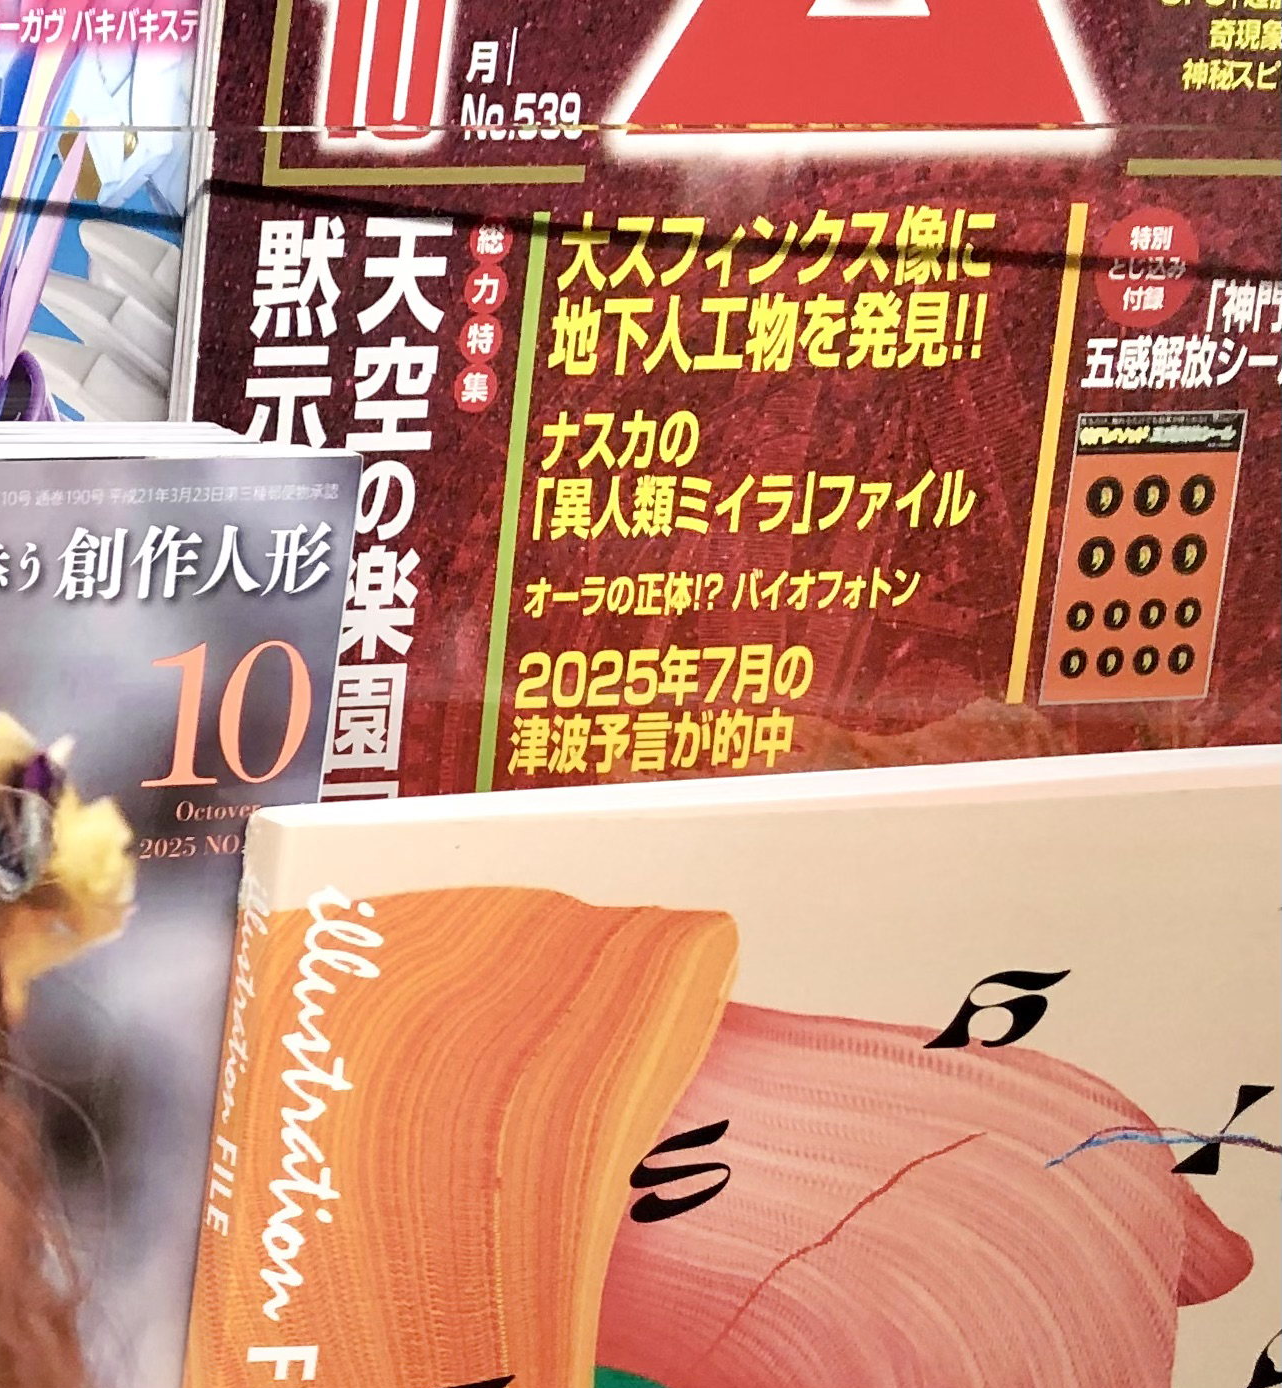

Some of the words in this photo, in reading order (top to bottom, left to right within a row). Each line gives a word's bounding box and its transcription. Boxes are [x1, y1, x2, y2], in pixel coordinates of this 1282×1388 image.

[466, 41, 499, 84] 月
[460, 92, 581, 141] No.539
[556, 205, 996, 292] 大スフィンクス像に
[245, 216, 344, 450] 黙示
[459, 224, 508, 405] 総力特集
[547, 293, 986, 376] 地下人工物を発見!!
[1080, 335, 1281, 391] 五感解放シー
[541, 410, 699, 468] ナスカの
[317, 217, 454, 800] 天空の楽園
[533, 469, 977, 540] 「異人類ミイラ」ファイル
[55, 520, 332, 601] 創作人形
[733, 567, 920, 609] バイオフォトン
[140, 638, 313, 788] 10
[516, 644, 813, 709] 2025年7月の
[508, 709, 794, 775] 津波予言が的中
[139, 836, 197, 860] 2025
[257, 885, 385, 1321] illustration
[204, 1132, 232, 1239] FILE
